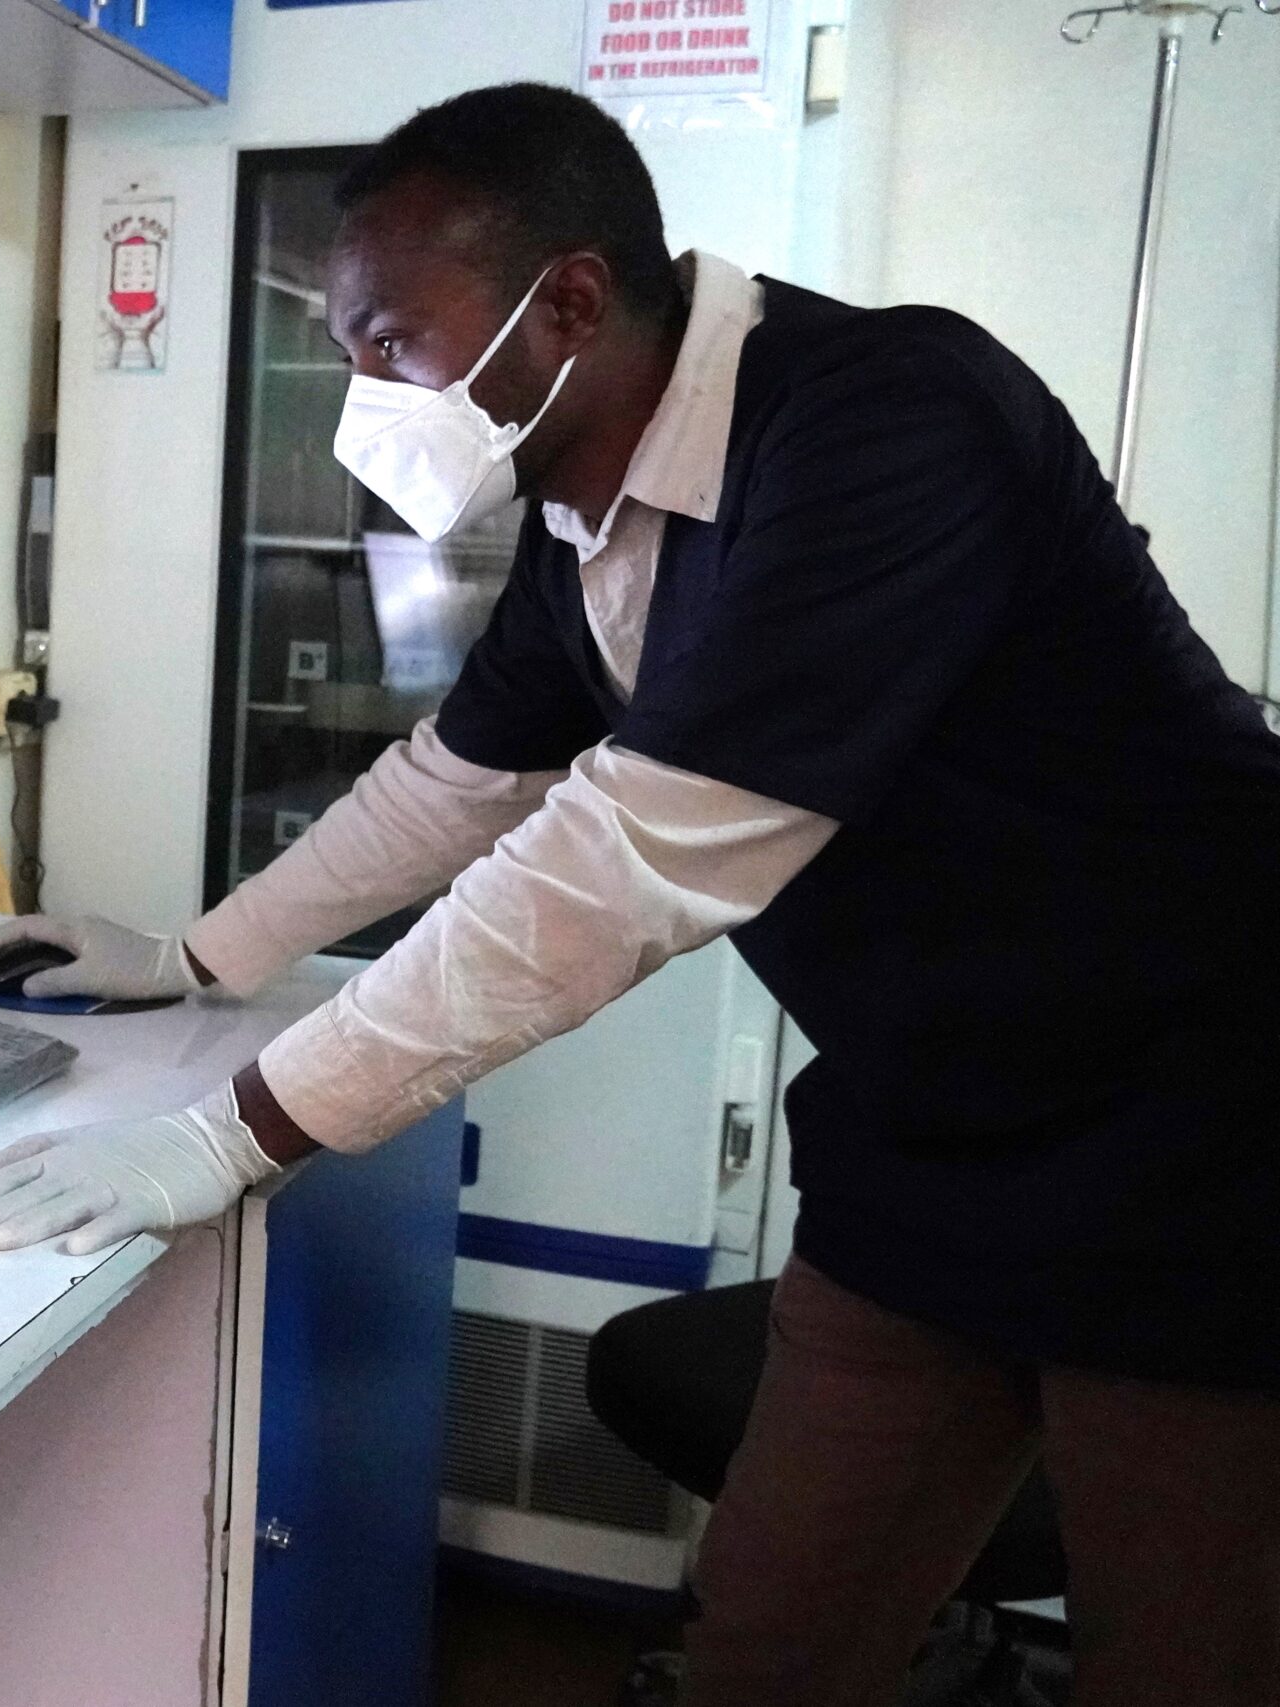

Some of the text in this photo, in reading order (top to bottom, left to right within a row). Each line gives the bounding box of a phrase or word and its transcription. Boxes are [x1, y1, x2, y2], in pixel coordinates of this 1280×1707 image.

[609, 0, 745, 22] DO NOT STORE
[601, 27, 749, 54] FOOD OR DRINK
[588, 58, 759, 81] IN THE REFRIGERATOR
